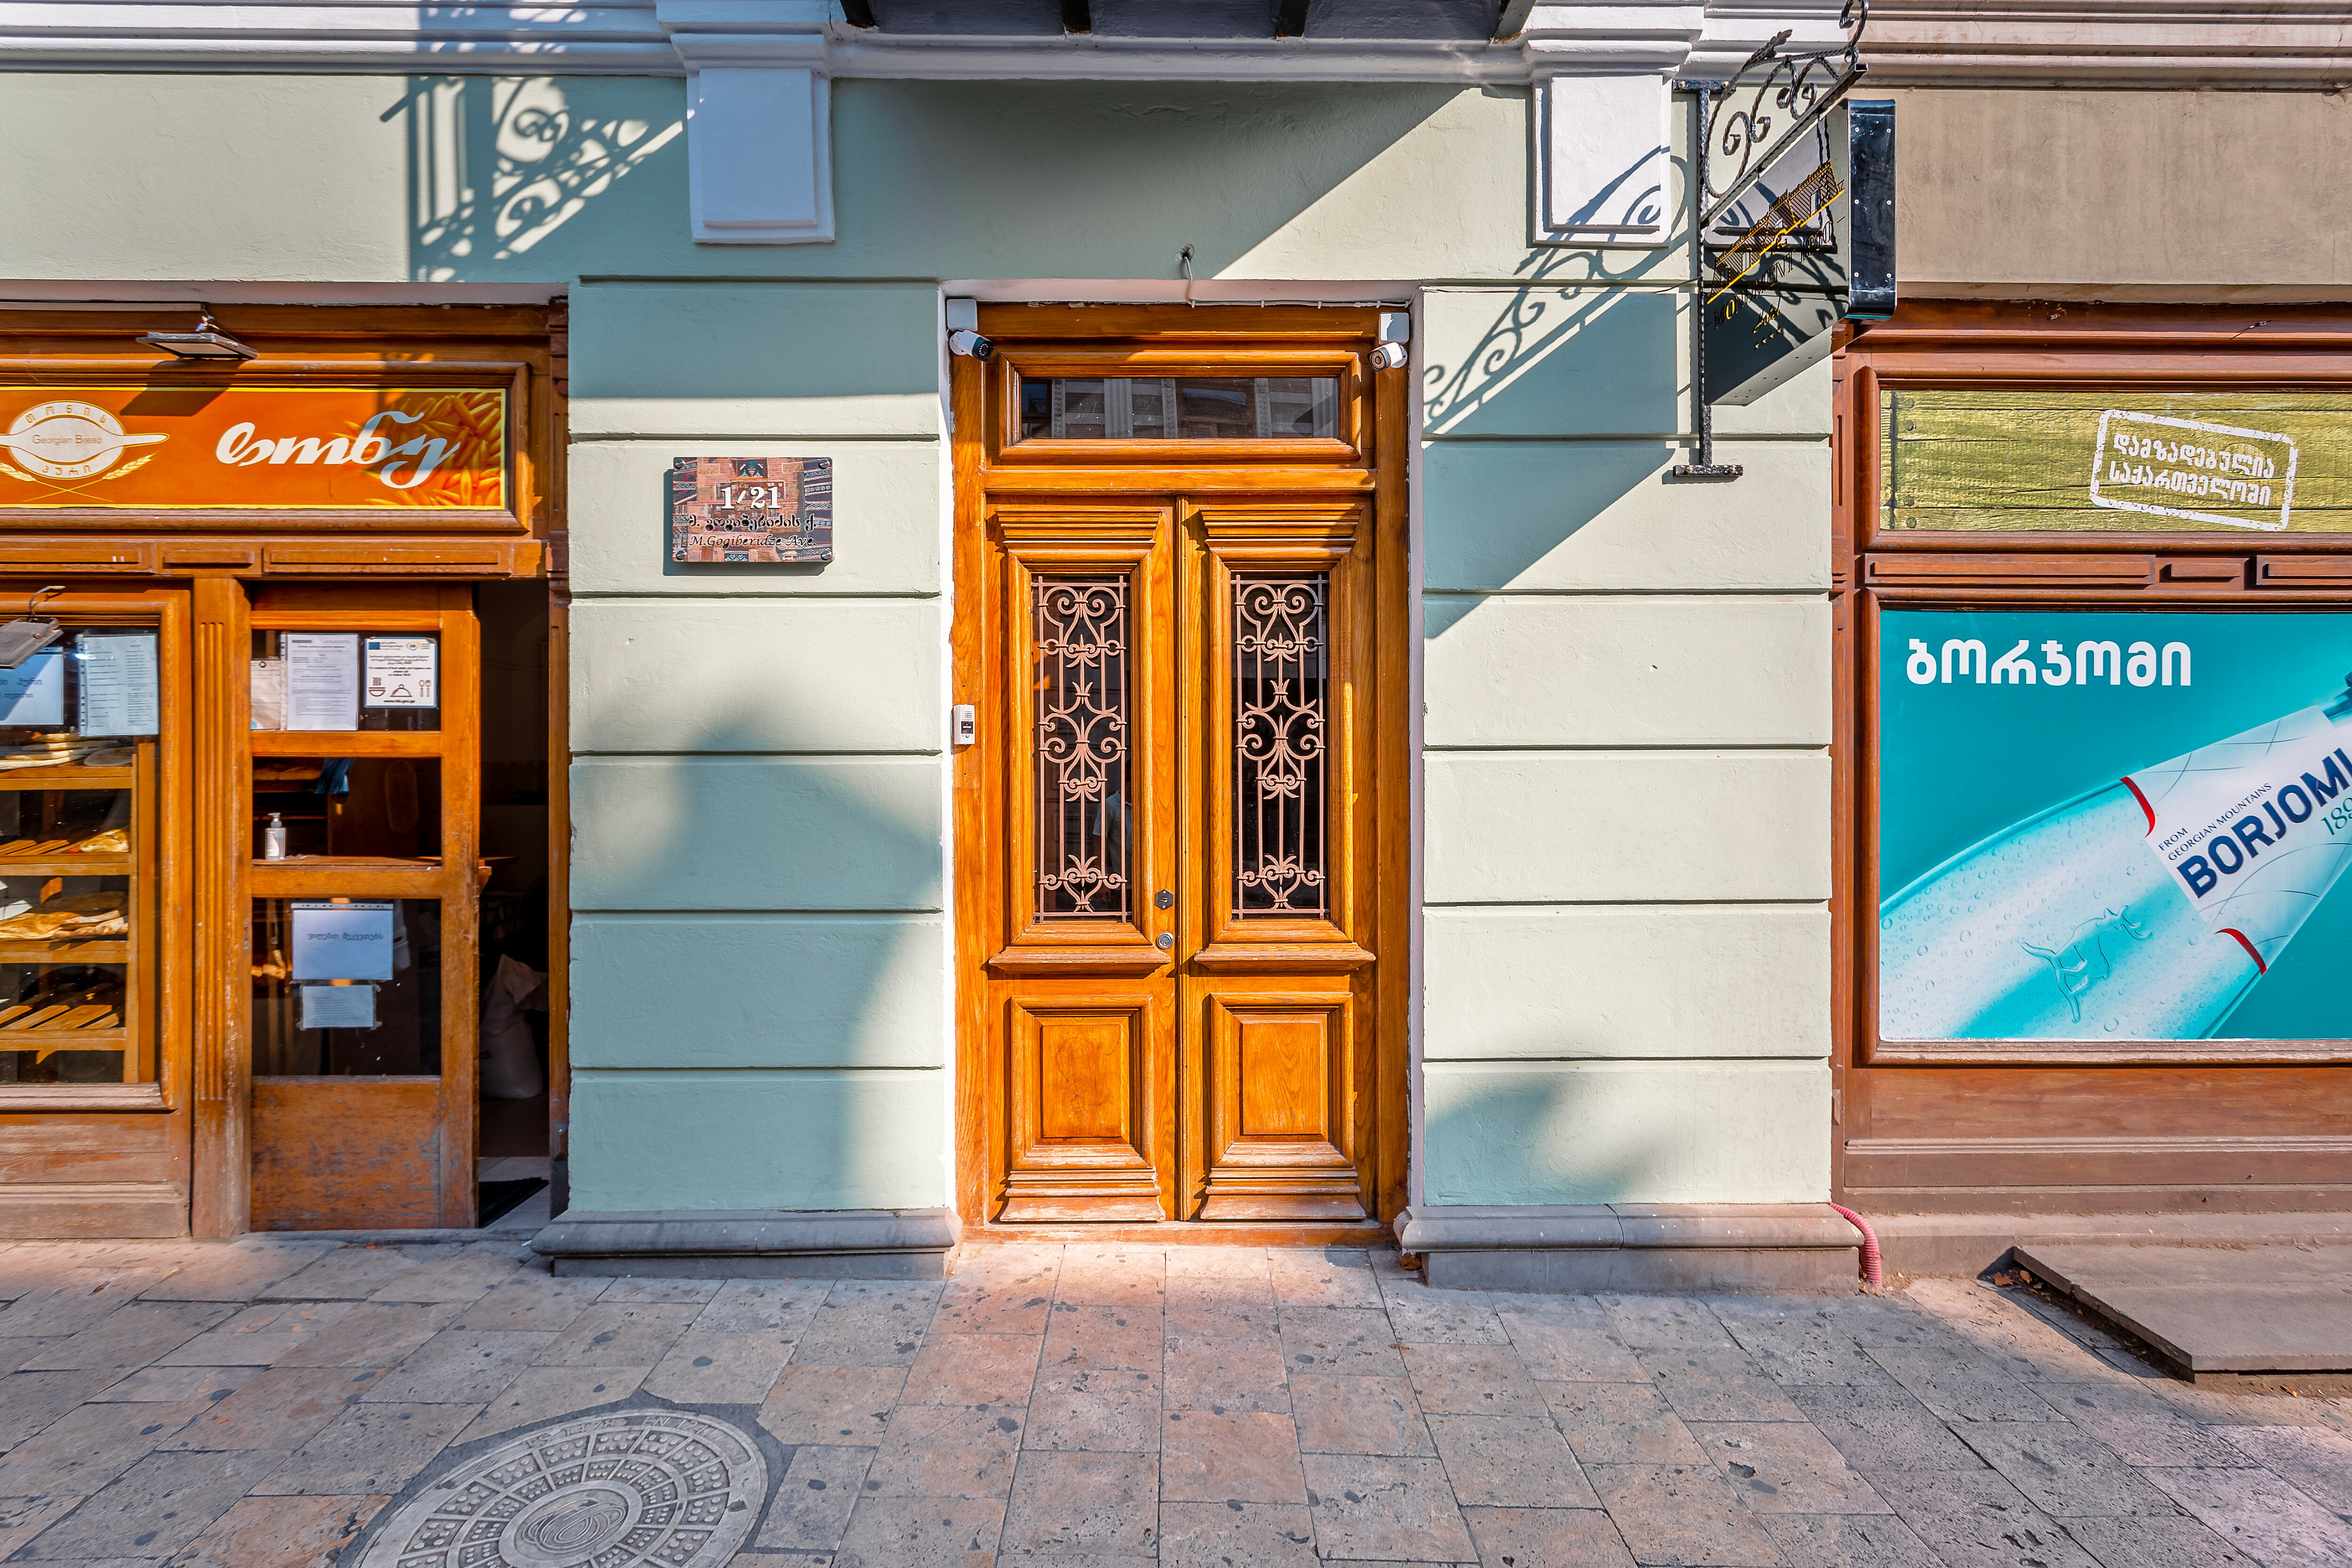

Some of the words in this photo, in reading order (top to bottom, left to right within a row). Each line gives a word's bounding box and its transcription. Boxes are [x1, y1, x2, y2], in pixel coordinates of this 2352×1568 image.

[1714, 249, 1795, 330] MONUMENT
[1753, 296, 1782, 333] Hotel
[25, 405, 107, 423] თონის
[32, 434, 72, 446] Georgian
[75, 434, 102, 444] Bread
[42, 465, 91, 476] პური
[2114, 434, 2275, 478] დამზადებულია
[721, 486, 781, 509] 1/21
[2109, 461, 2271, 506] საქართველოში
[689, 514, 700, 527] მ.
[706, 514, 801, 532] გოგიბერიძის
[805, 514, 817, 532] ქ.
[786, 535, 816, 546] Ave.
[1907, 638, 2191, 687] ბორჯომი
[2168, 823, 2217, 860] GEORGIAN
[2216, 783, 2272, 826] MOUNTAINS
[2176, 747, 2352, 899] BORJOMI
[2158, 828, 2188, 851] FROM
